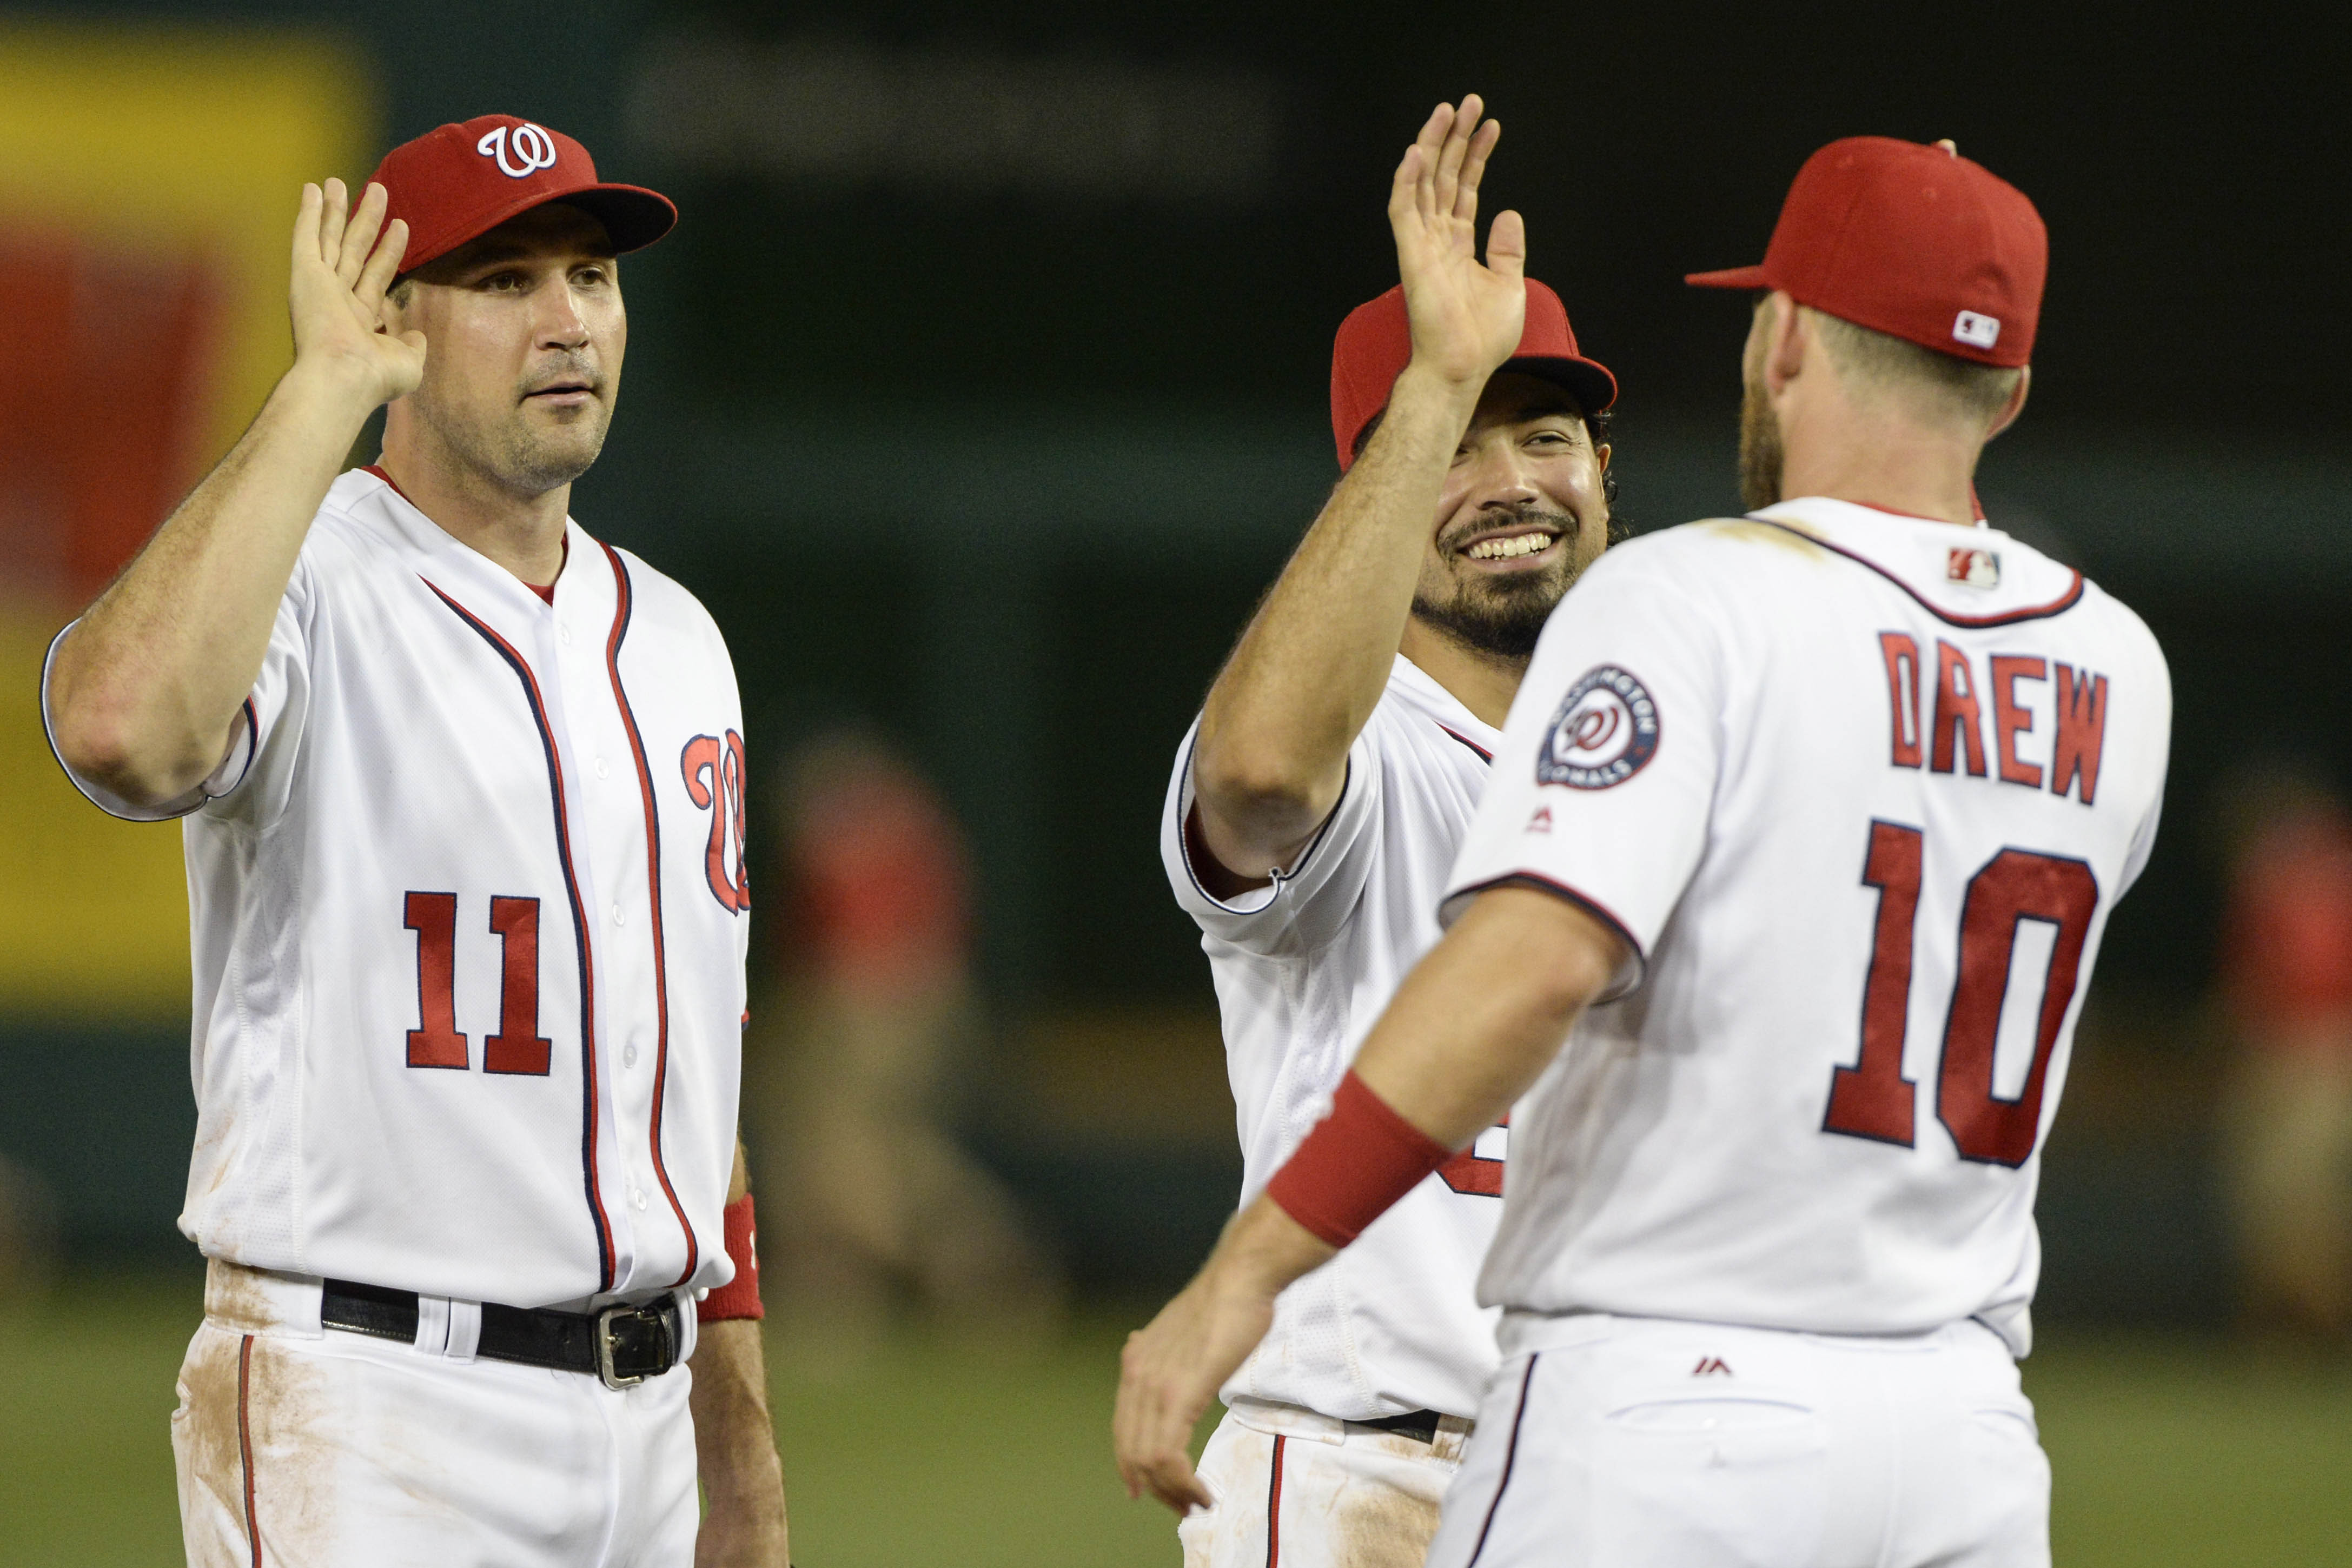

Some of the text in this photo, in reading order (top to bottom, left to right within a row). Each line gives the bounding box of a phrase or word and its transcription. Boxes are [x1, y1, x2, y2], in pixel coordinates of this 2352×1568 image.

[1878, 630, 2109, 806] DREW
[403, 890, 552, 1076] 11
[1820, 816, 2099, 1170] 10
